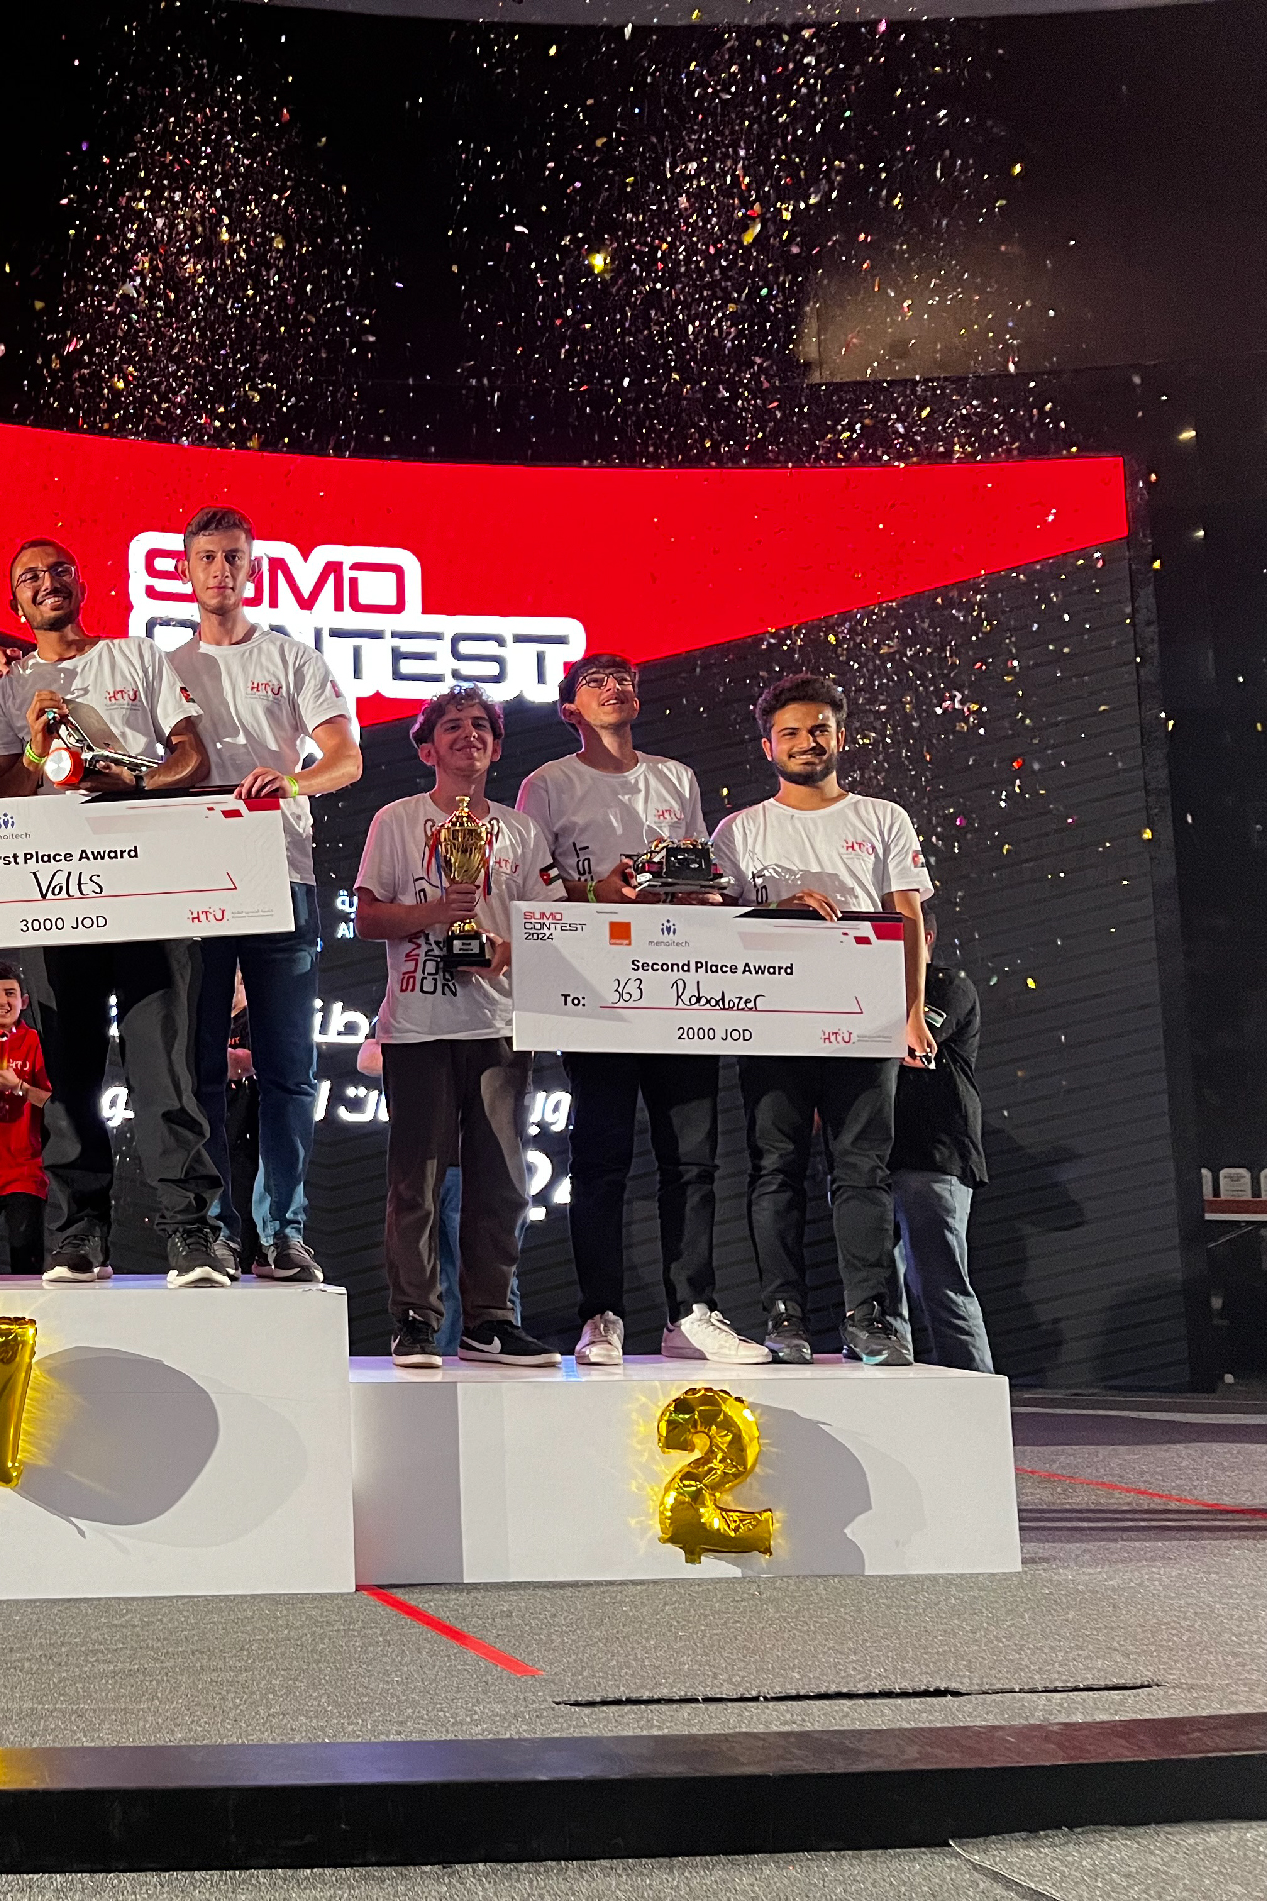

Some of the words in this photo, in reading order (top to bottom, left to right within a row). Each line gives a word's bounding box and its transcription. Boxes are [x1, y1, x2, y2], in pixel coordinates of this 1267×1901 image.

[105, 686, 139, 703] HTU
[248, 679, 283, 696] HTU
[23, 850, 73, 864] Place
[78, 845, 139, 861] Award
[29, 869, 104, 900] Volts
[19, 916, 65, 933] 3000
[71, 914, 108, 930] JOD
[523, 911, 563, 921] SUMO
[523, 921, 587, 932] CONTEST
[524, 932, 554, 941] 2024
[631, 959, 690, 974] Second
[695, 960, 738, 975] Place
[741, 962, 794, 976] Award
[561, 993, 586, 1007] To:
[611, 977, 644, 1005] 363
[670, 978, 766, 1011] Robodozer
[677, 1026, 716, 1041] 2000
[721, 1027, 753, 1042] JOD
[656, 1387, 774, 1564] 2
